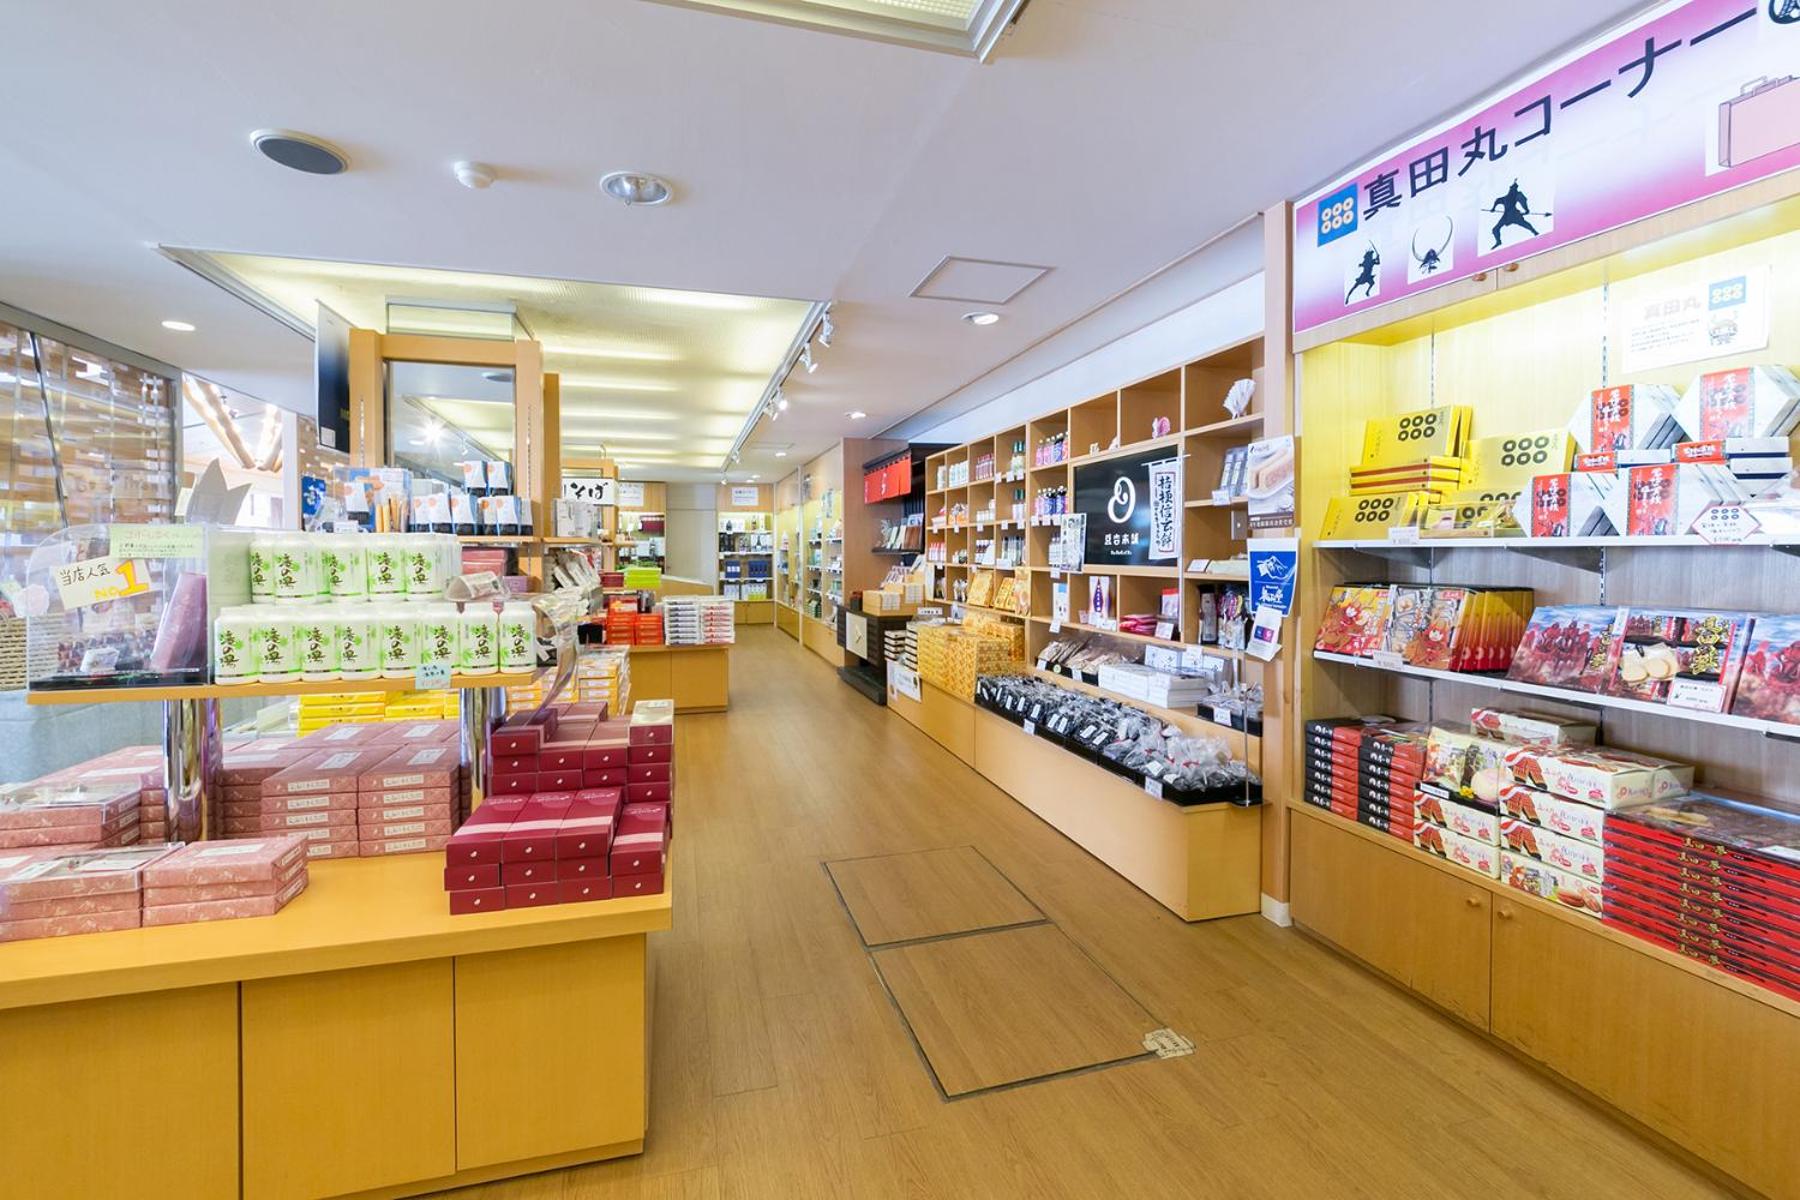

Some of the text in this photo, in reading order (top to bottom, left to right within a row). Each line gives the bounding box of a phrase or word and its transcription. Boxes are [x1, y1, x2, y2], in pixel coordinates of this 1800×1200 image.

[1363, 7, 1757, 220] 真田丸コーナー
[570, 482, 608, 500] そば
[60, 563, 110, 586] 当店人気
